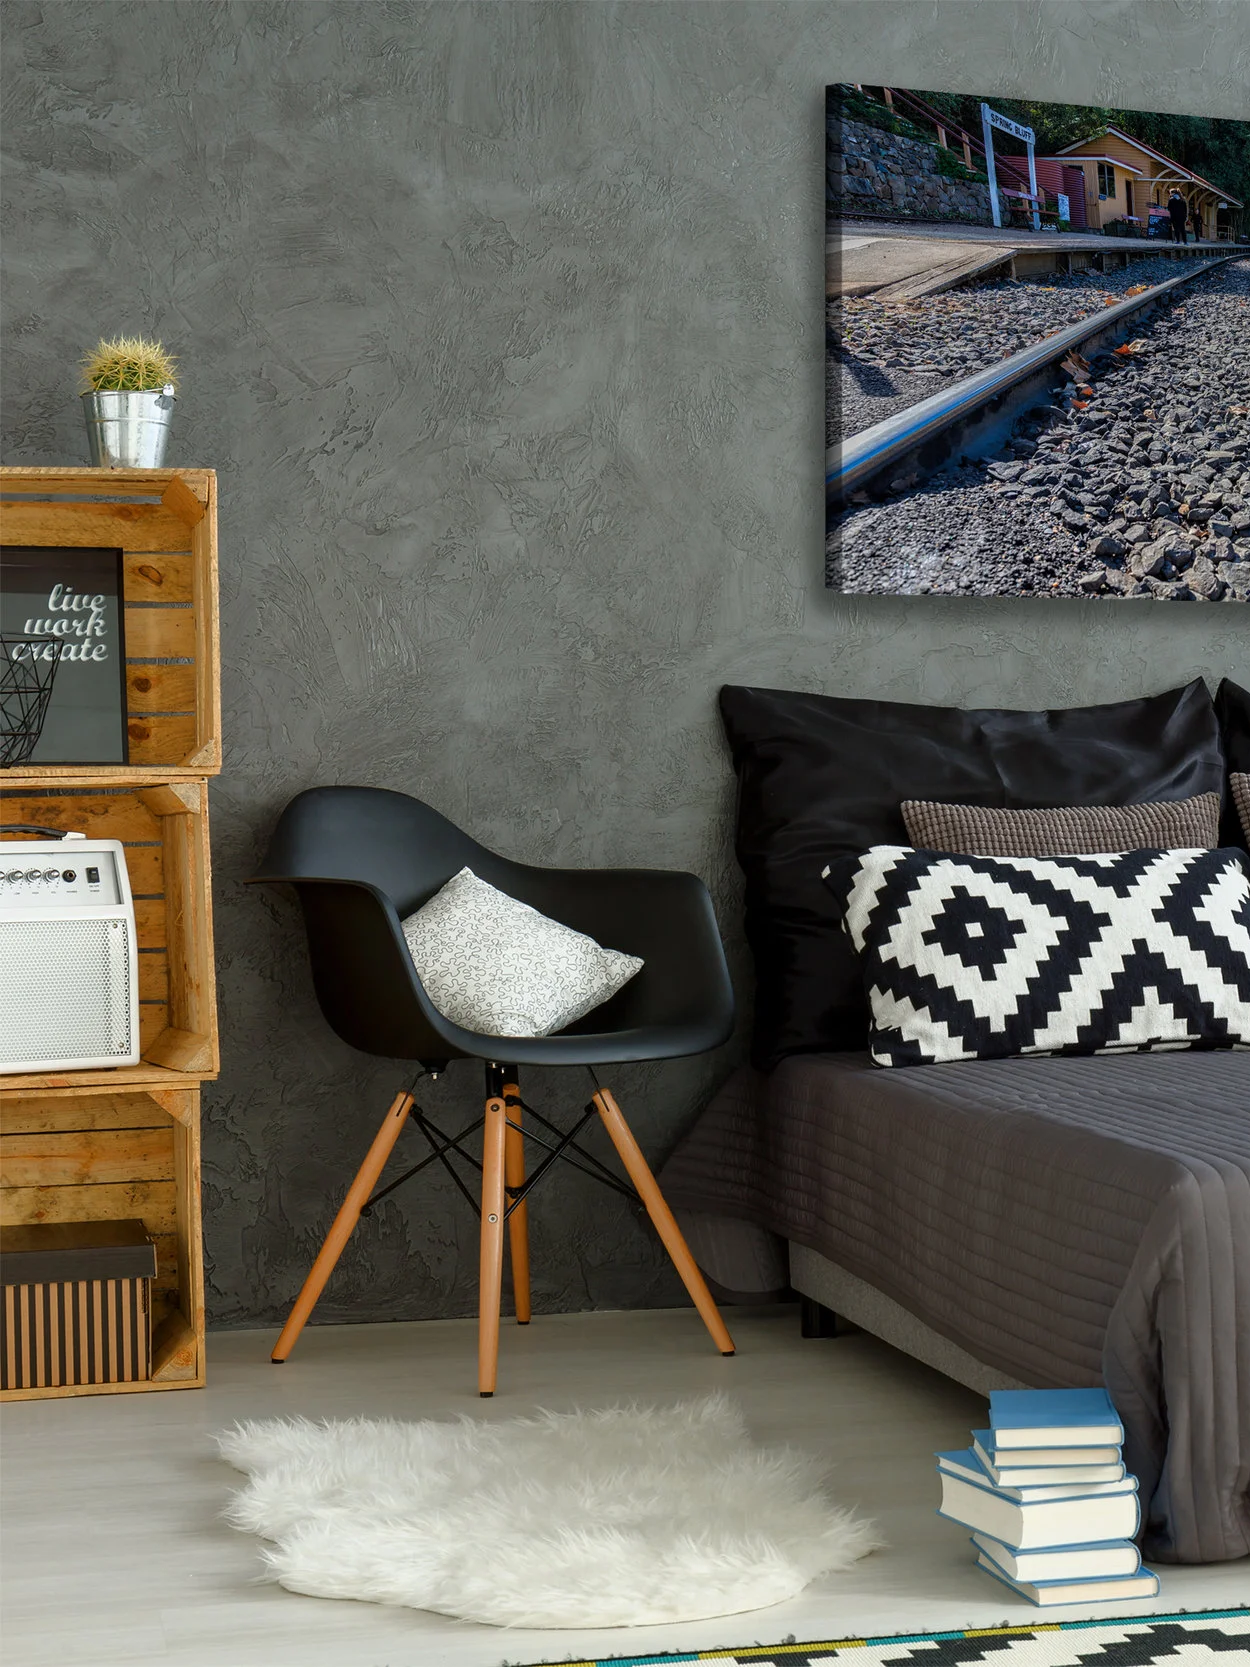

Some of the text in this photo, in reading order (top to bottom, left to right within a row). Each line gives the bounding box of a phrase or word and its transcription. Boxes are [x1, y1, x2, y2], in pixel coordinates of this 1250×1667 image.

[1014, 125, 1032, 140] BLUFF
[48, 583, 107, 611] live
[24, 609, 108, 637] work
[12, 638, 109, 662] create
